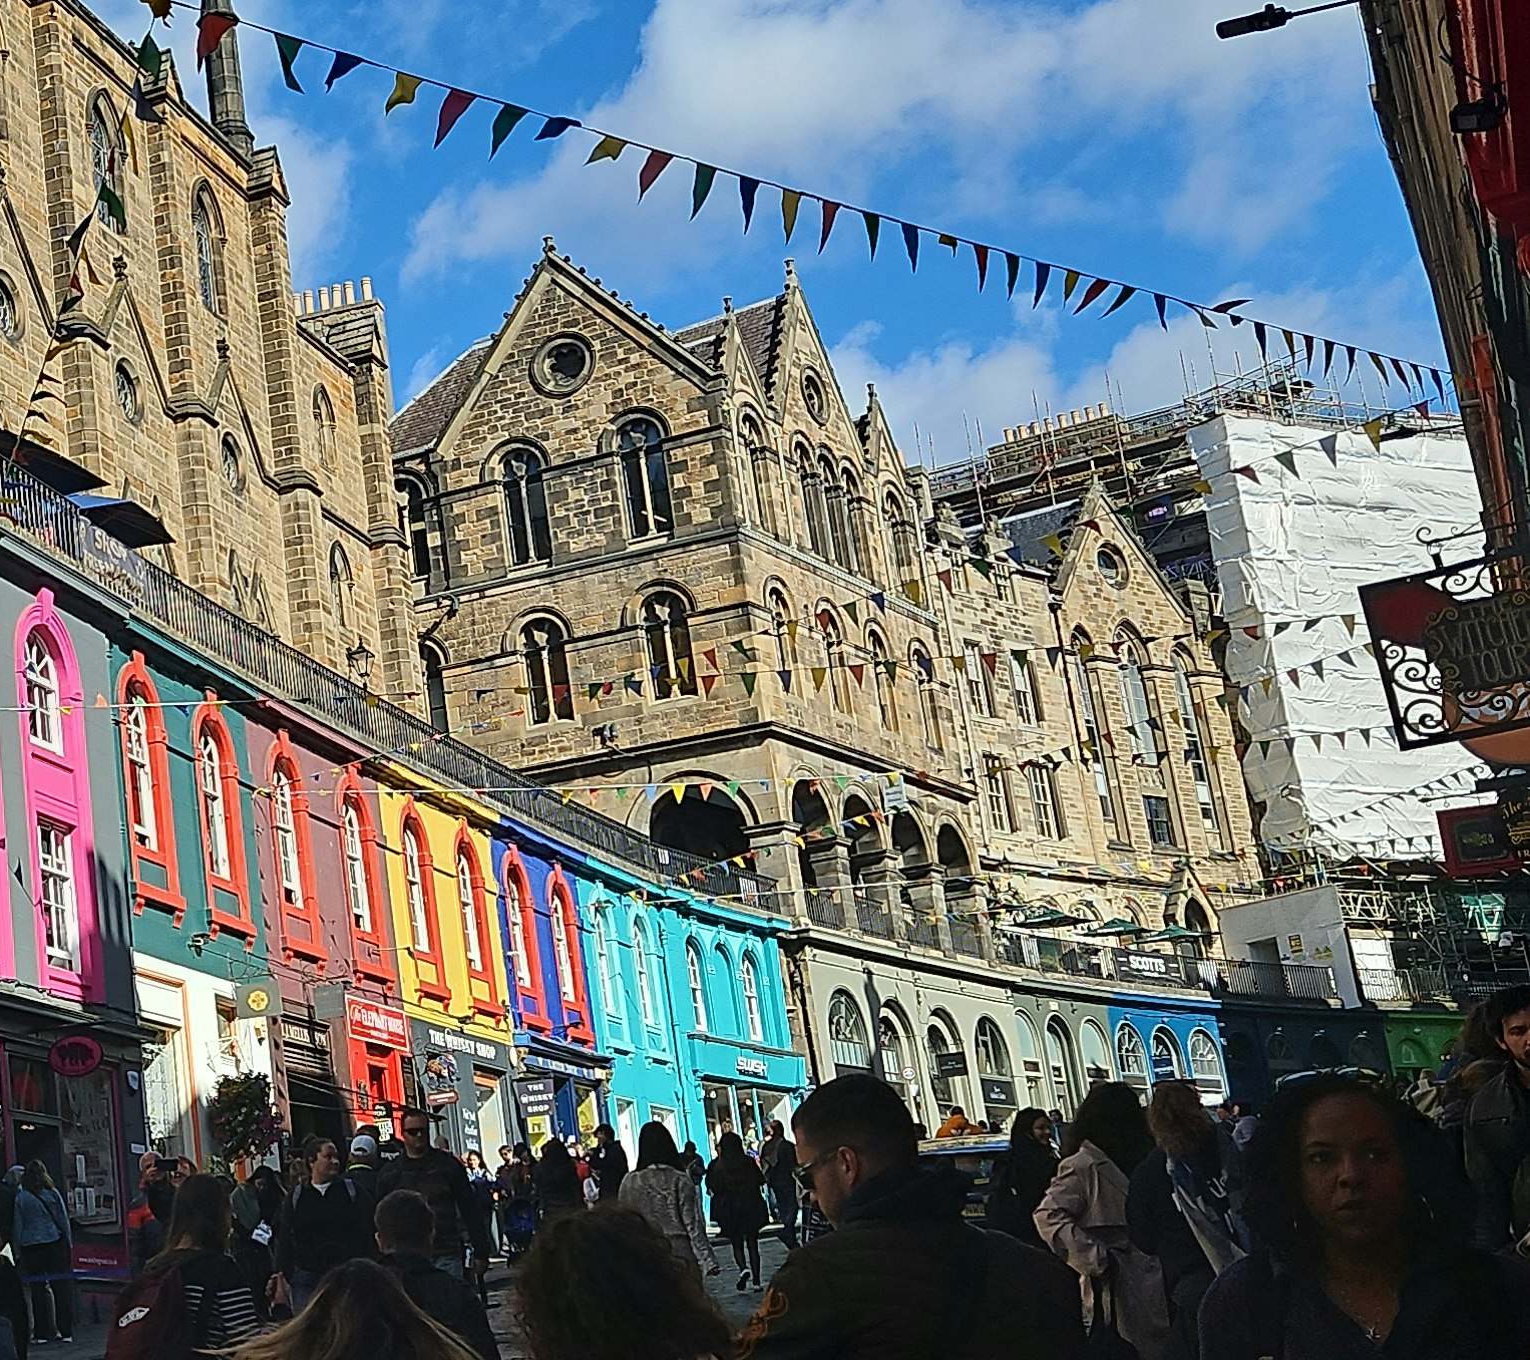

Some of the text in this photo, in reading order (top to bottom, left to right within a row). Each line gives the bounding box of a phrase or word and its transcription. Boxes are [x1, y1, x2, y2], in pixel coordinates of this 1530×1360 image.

[1440, 609, 1530, 658] WITCHE
[1128, 955, 1166, 973] SCOTTS
[428, 1028, 446, 1047] THE
[476, 1041, 497, 1060] SHOP
[527, 1083, 544, 1092] THE
[520, 1093, 554, 1104] WHISKY
[527, 1104, 550, 1113] SHOP
